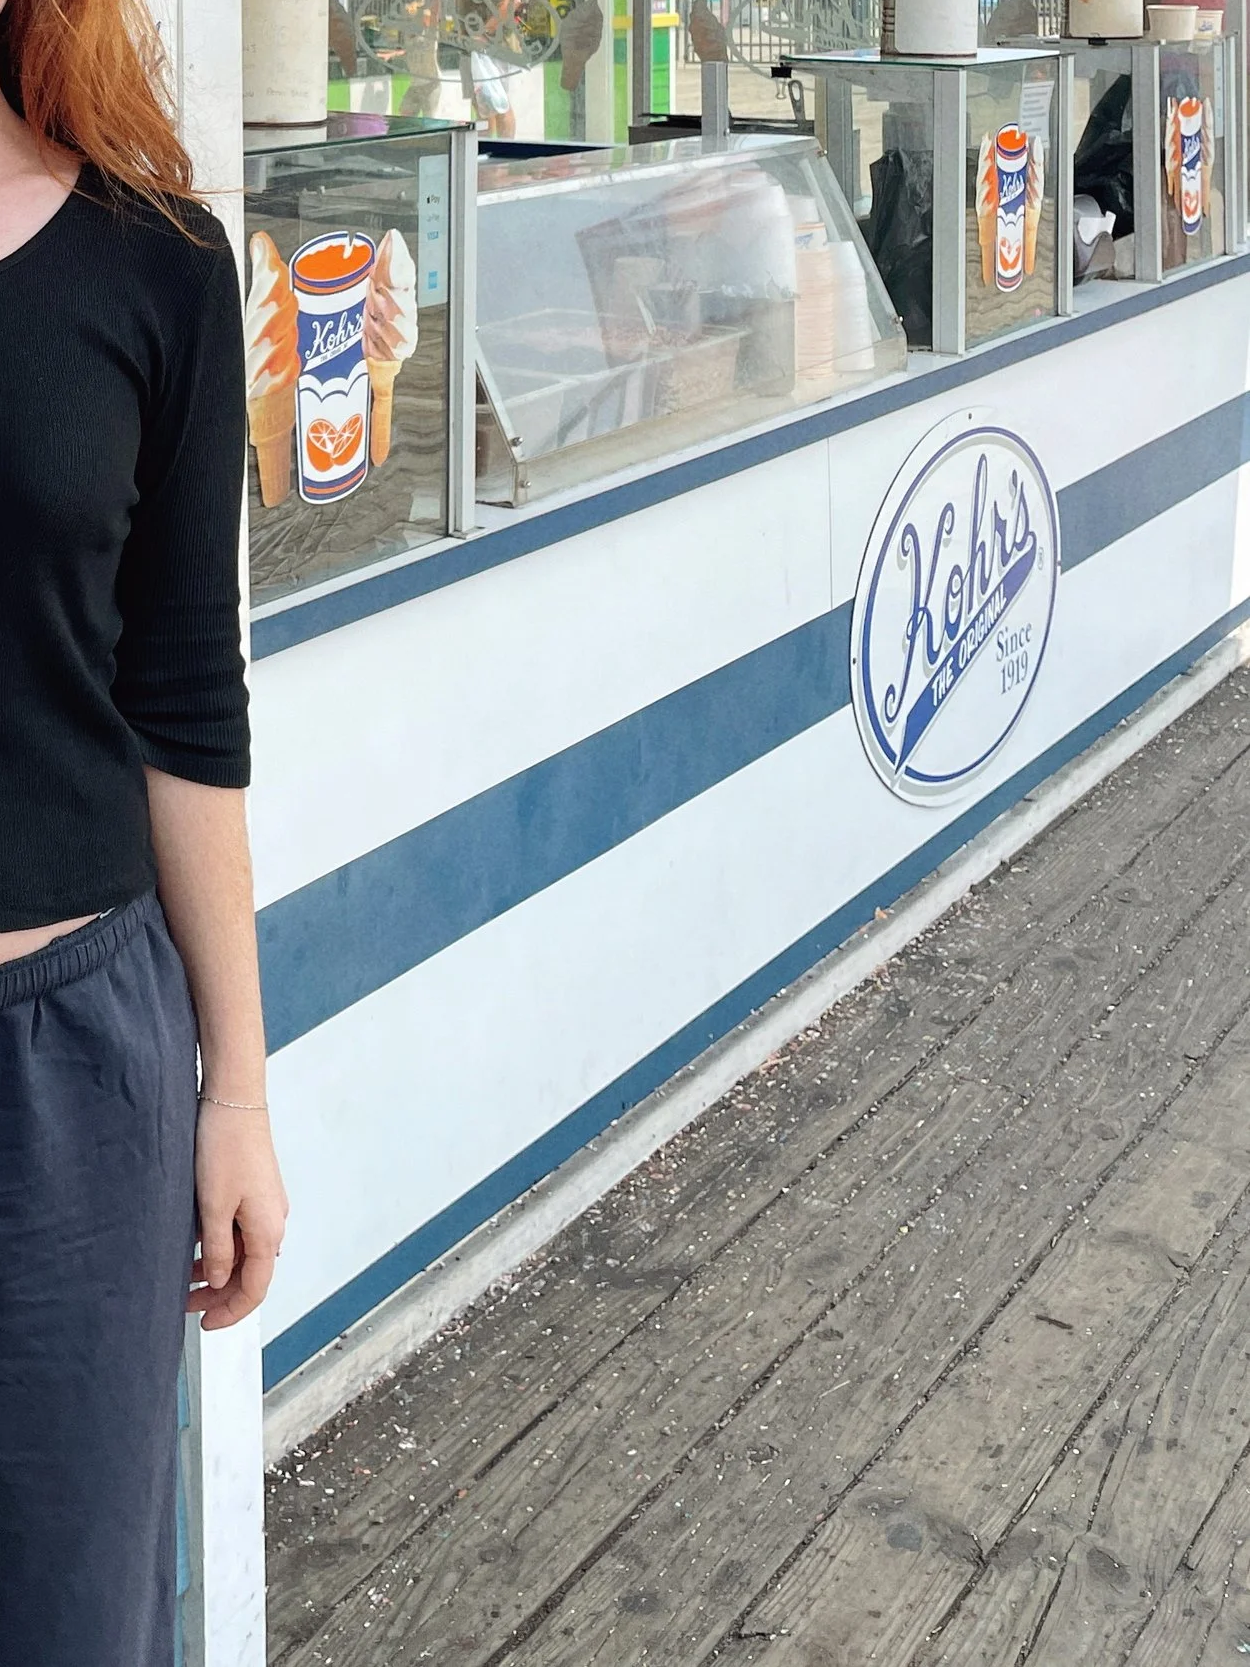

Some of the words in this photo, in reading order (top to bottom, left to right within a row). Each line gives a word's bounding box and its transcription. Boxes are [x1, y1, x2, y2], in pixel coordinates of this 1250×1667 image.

[305, 310, 364, 360] Kohr's
[884, 452, 1036, 724] Kohr's
[931, 657, 956, 708] THE
[958, 584, 1008, 670] ORIGINAL
[995, 621, 1033, 663] Since
[999, 649, 1029, 697] 1919
